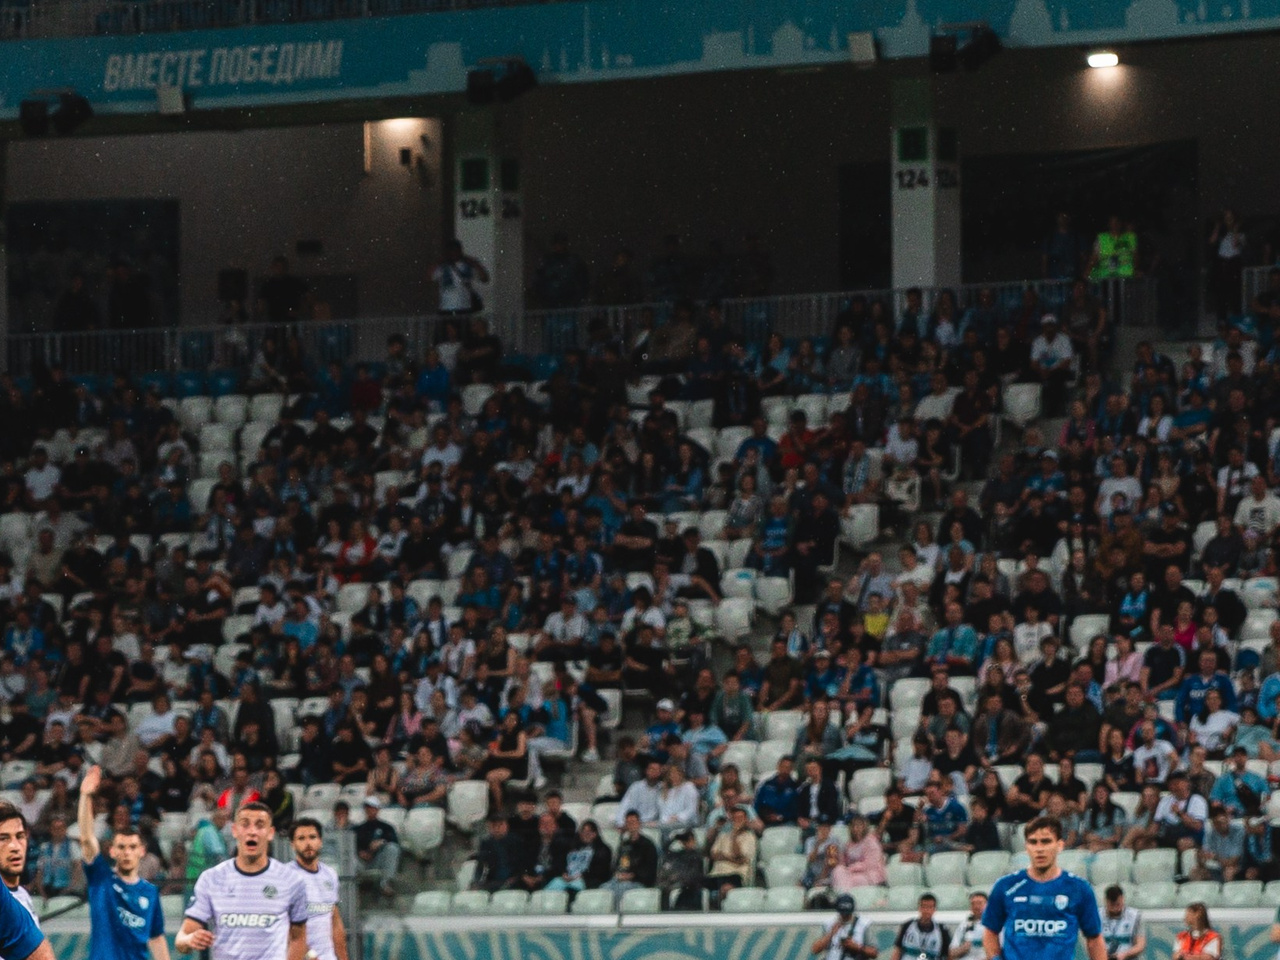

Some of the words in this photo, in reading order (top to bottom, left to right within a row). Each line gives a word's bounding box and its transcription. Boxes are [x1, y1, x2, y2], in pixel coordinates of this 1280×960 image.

[103, 49, 207, 92] ВМЕСТЕ
[208, 40, 344, 85] ПОБЕДИМ!
[220, 913, 277, 928] FONBET
